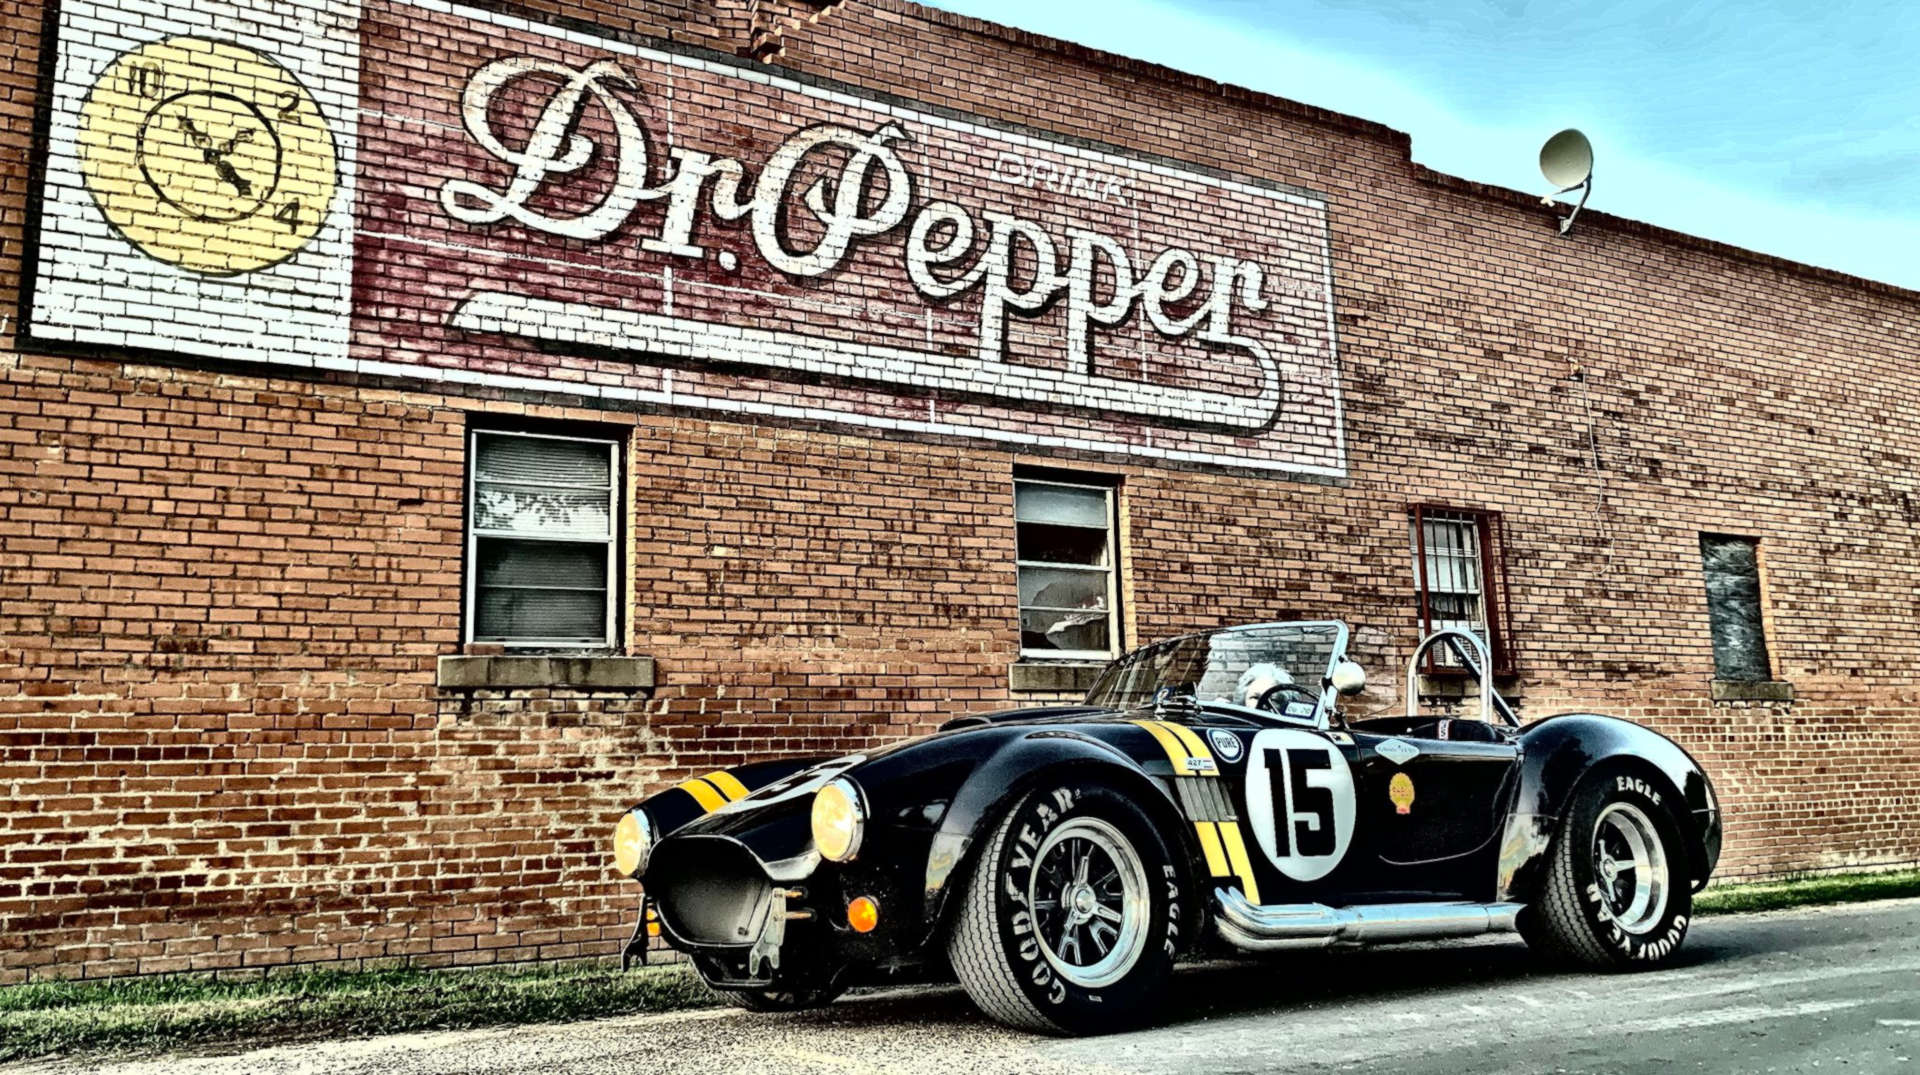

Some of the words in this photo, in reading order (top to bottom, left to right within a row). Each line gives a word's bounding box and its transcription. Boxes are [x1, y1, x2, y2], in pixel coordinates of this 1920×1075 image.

[129, 61, 161, 98] 10
[278, 91, 300, 121] 2
[989, 152, 1130, 206] DRINK
[274, 198, 302, 235] 4
[752, 121, 1268, 376] Pepper
[1215, 737, 1237, 748] PURE
[1263, 749, 1336, 858] 15
[1616, 776, 1661, 805] EAGLE
[1005, 787, 1074, 1004] GOODYEAR
[1162, 864, 1181, 958] EAGLE
